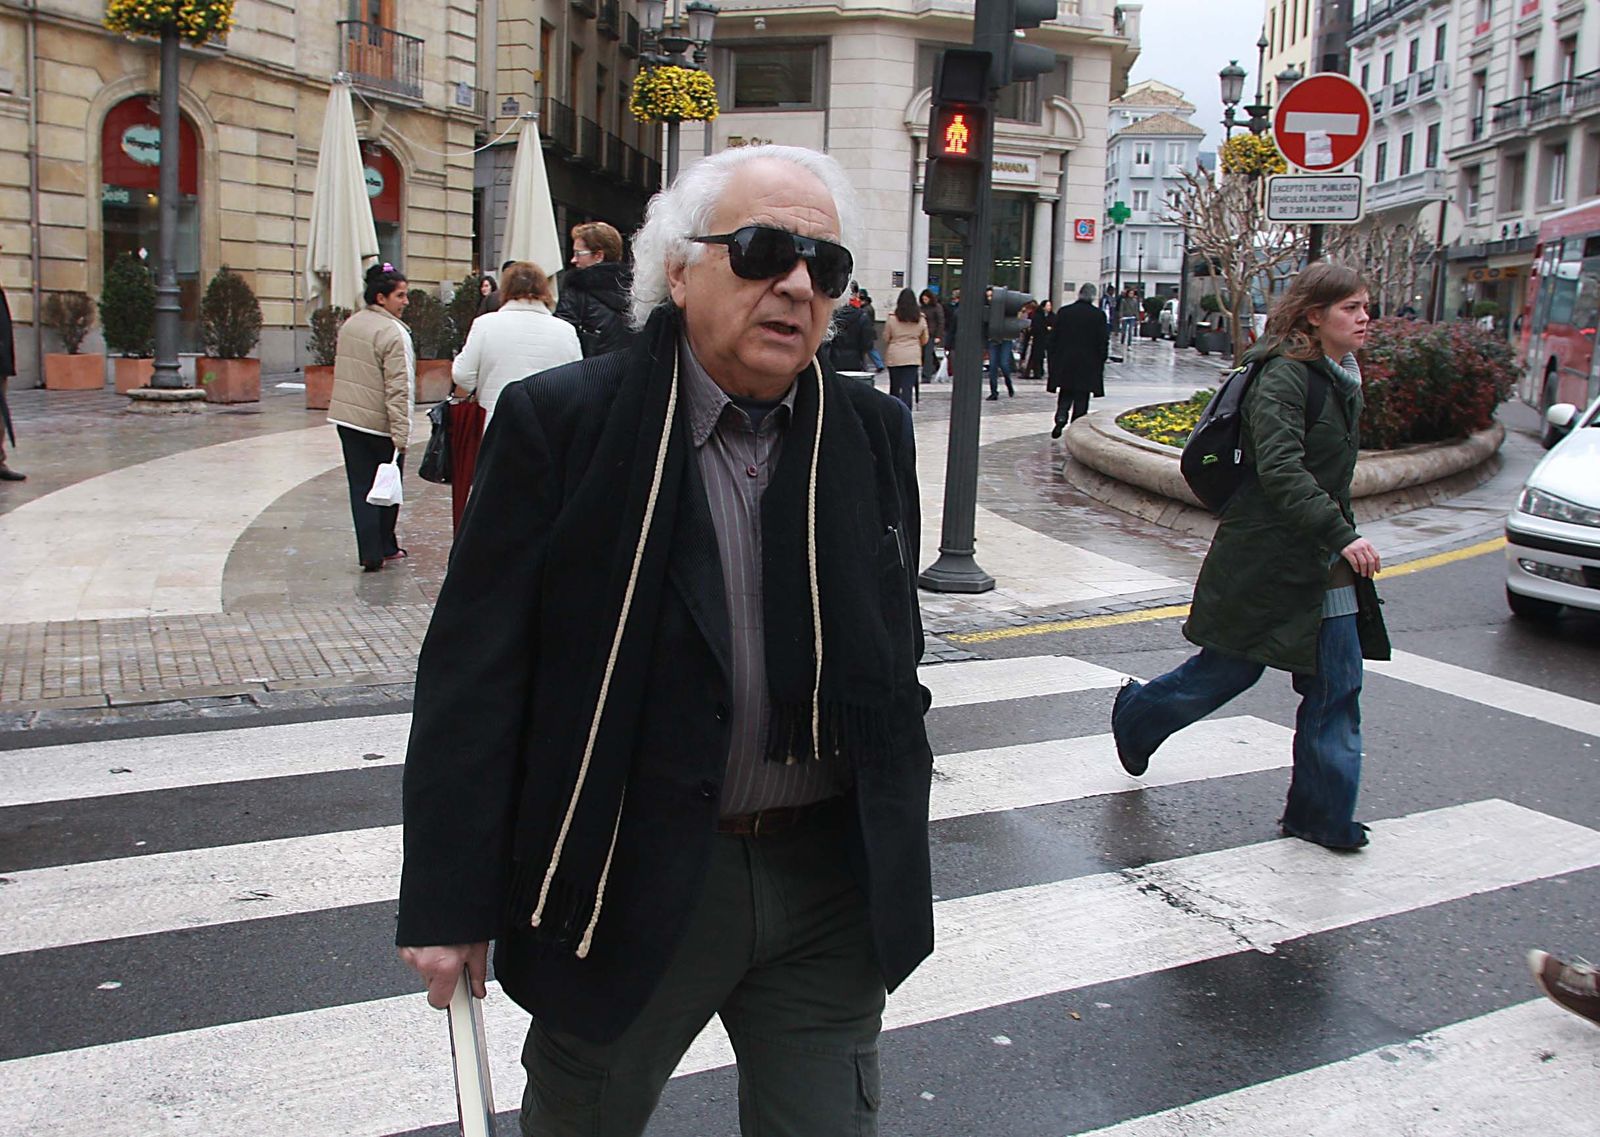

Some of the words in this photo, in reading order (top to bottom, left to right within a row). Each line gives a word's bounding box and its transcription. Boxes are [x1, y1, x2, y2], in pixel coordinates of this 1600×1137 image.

[992, 161, 1029, 173] RANADA
[1273, 184, 1303, 193] EXCEPTO
[1353, 183, 1359, 191] Y
[1310, 194, 1358, 202] AUTORIZADOS
[1279, 206, 1287, 214] DE
